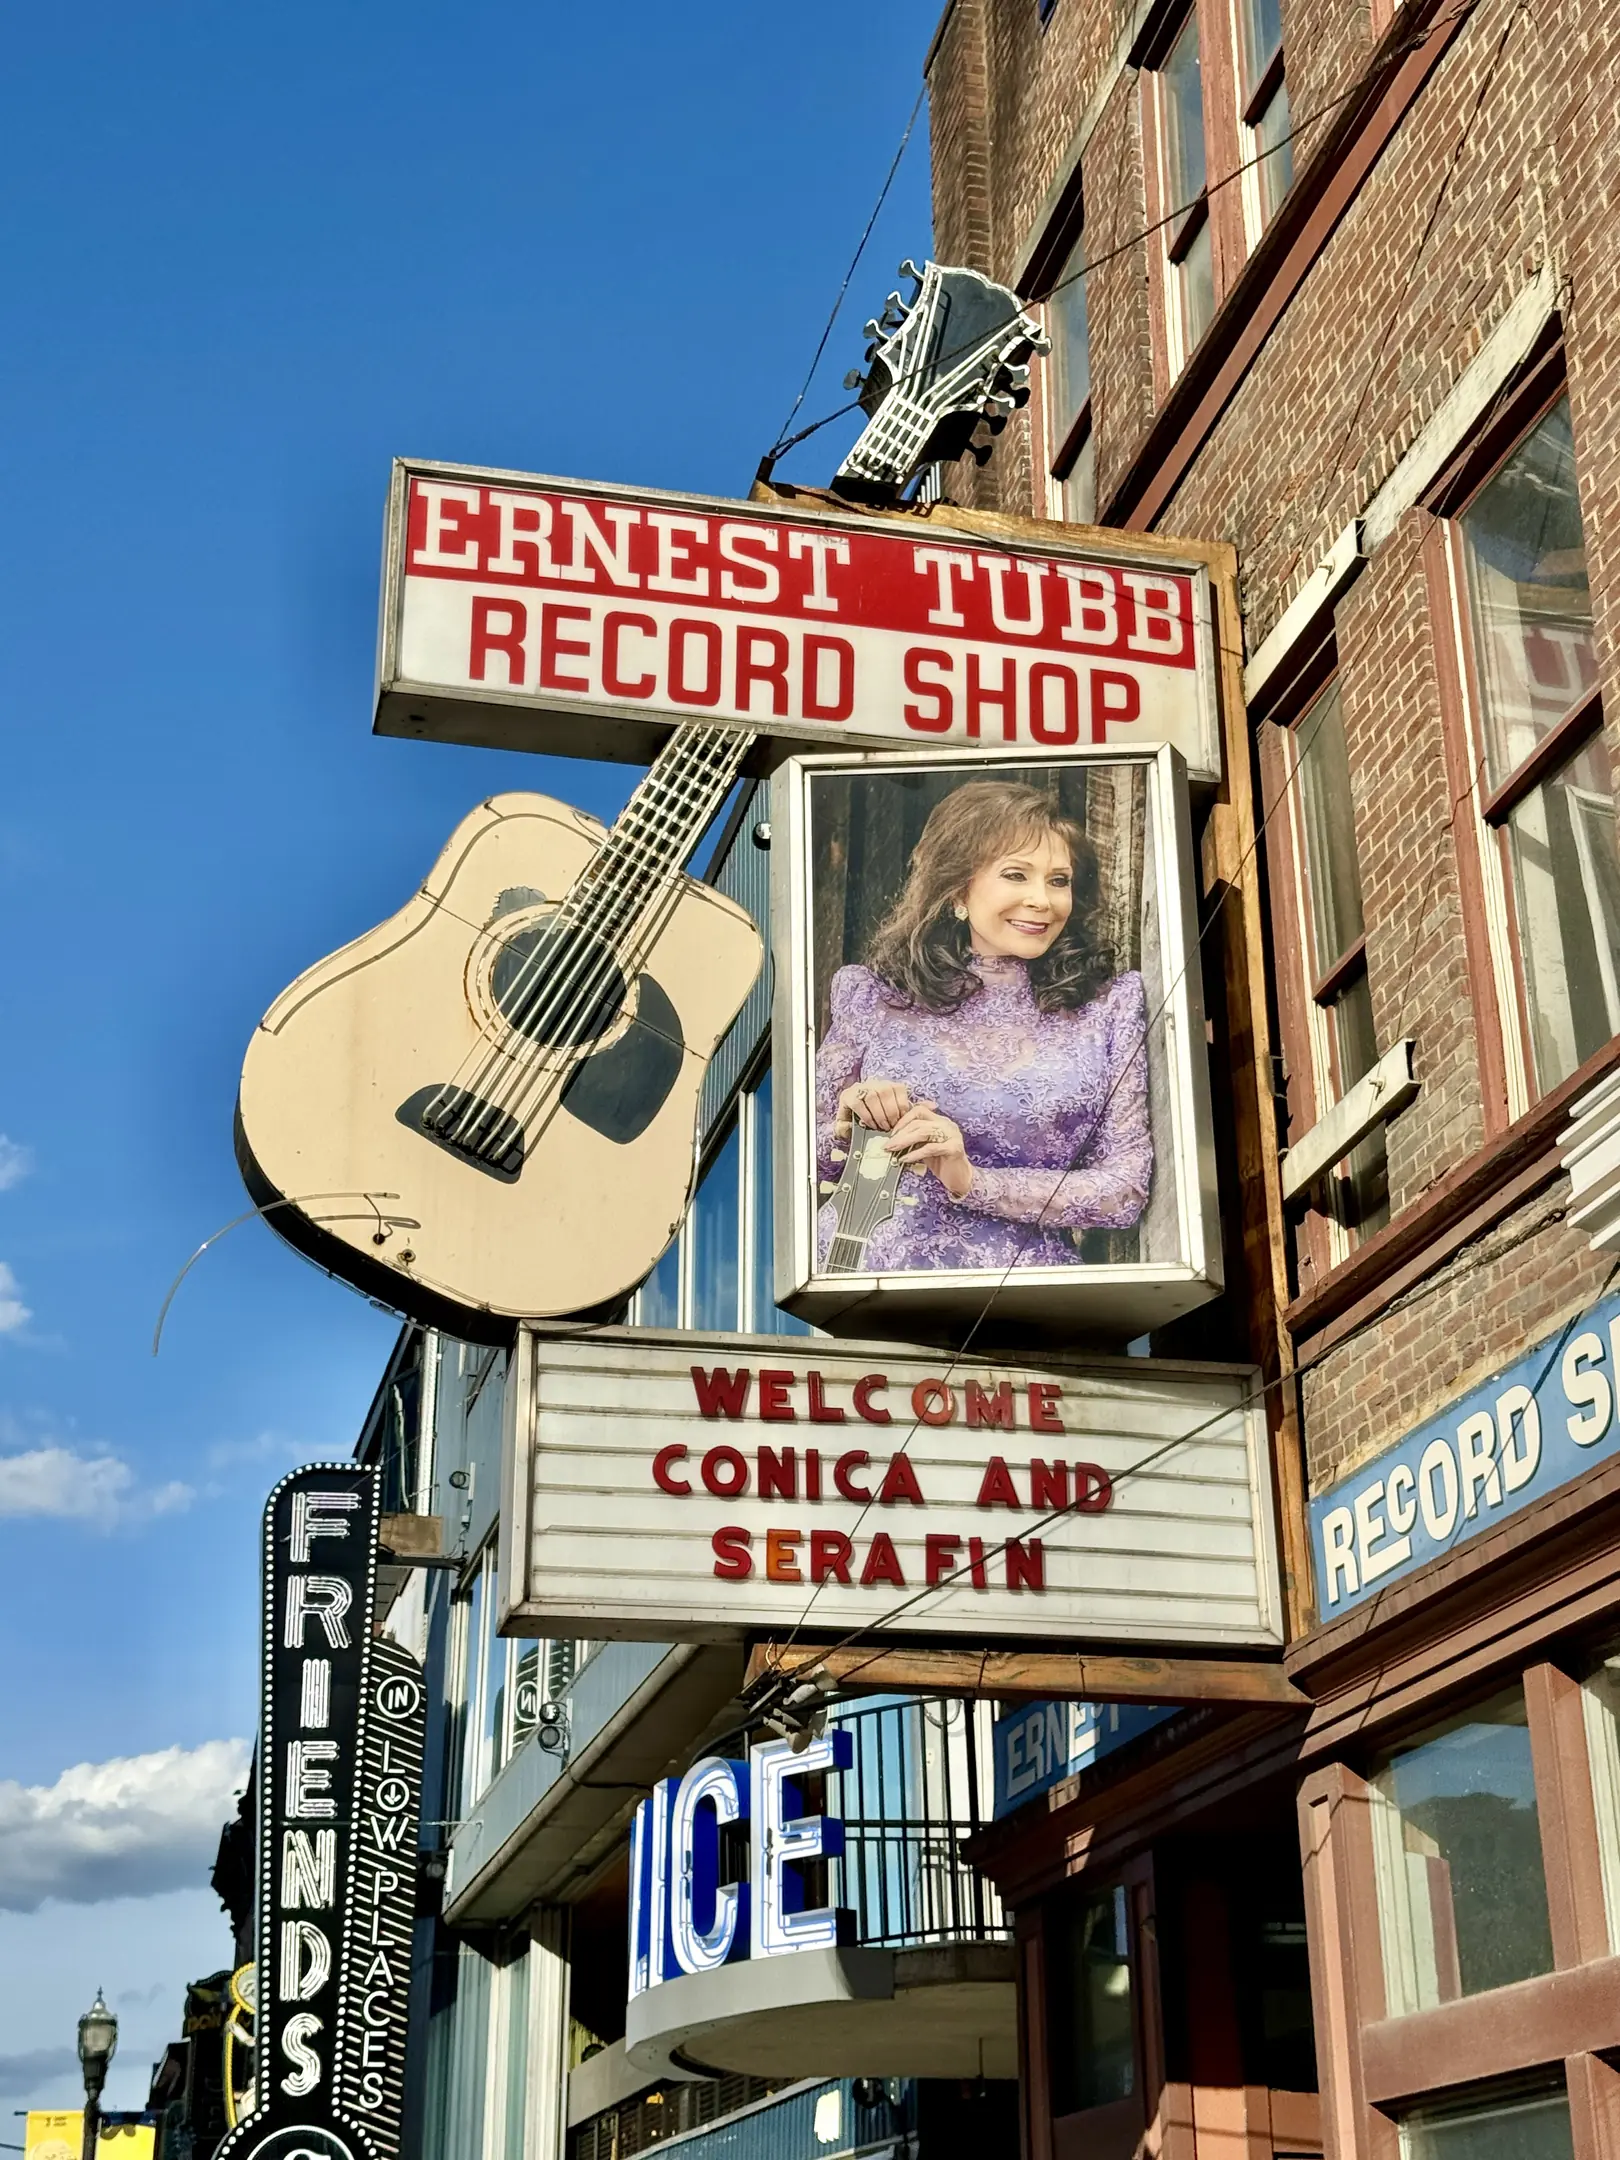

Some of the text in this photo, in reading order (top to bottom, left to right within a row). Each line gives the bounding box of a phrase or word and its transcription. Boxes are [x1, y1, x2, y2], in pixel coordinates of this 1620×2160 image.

[412, 480, 1183, 656] ERNEST TUBB
[468, 596, 1141, 746] RECORD SHOP
[653, 1443, 1113, 1513] CONICA AND
[690, 1365, 1066, 1433] WELCOME
[711, 1525, 1047, 1593] SERAFIN
[1321, 1384, 1542, 1606] RECORD
[279, 1491, 362, 2097] FRIENDS
[370, 1740, 410, 1850] LOW
[627, 1729, 852, 2003] ICE
[358, 1871, 399, 2110] PLACES
